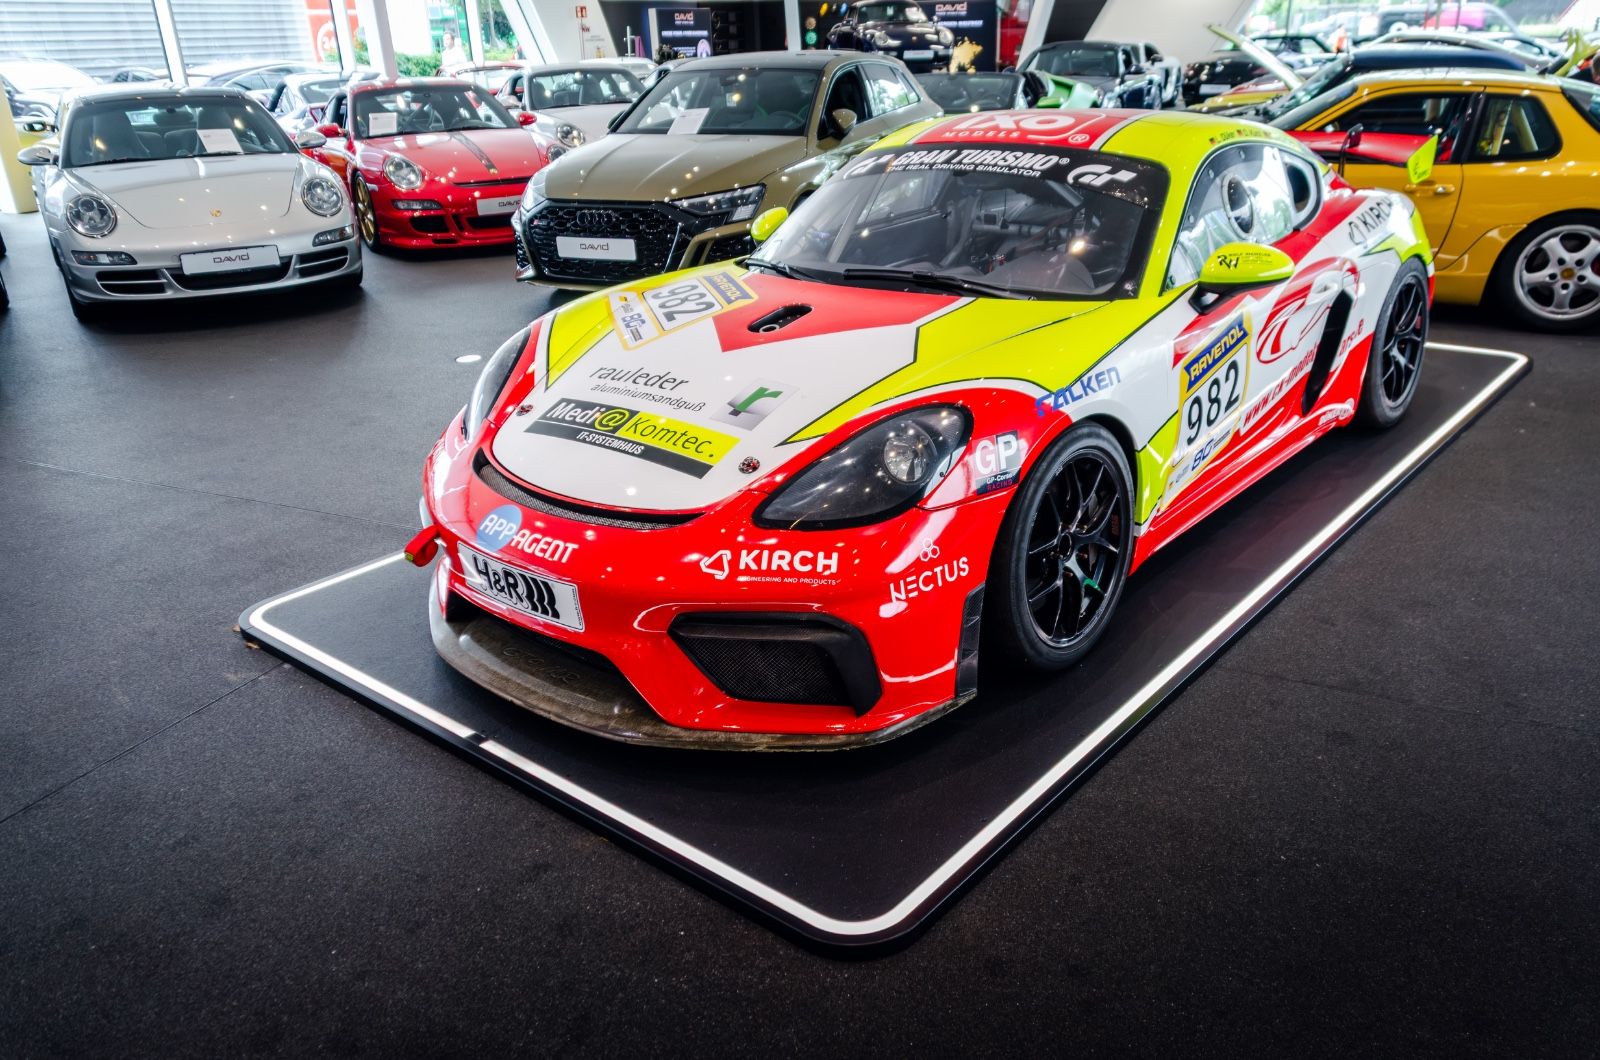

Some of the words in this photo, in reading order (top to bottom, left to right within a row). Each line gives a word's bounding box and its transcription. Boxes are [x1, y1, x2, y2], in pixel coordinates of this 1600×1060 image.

[942, 130, 1021, 138] MODELS
[891, 150, 958, 166] GRAN
[932, 163, 975, 171] DRIVING
[976, 165, 1042, 177] SIMULATOR
[651, 284, 715, 323] 982
[1189, 325, 1245, 381] RAVENOL
[589, 365, 690, 391] rauleder
[1035, 366, 1120, 417] FALKEN
[590, 383, 706, 412] aluminiumsandguß
[1186, 359, 1240, 446] 982
[576, 430, 645, 455] IT-SYSTEMHAUS
[975, 434, 1018, 474] GP
[739, 549, 838, 573] KIRCH
[472, 553, 524, 603] H&R
[799, 577, 837, 585] PRODUCTS
[889, 556, 970, 602] NECTUS
